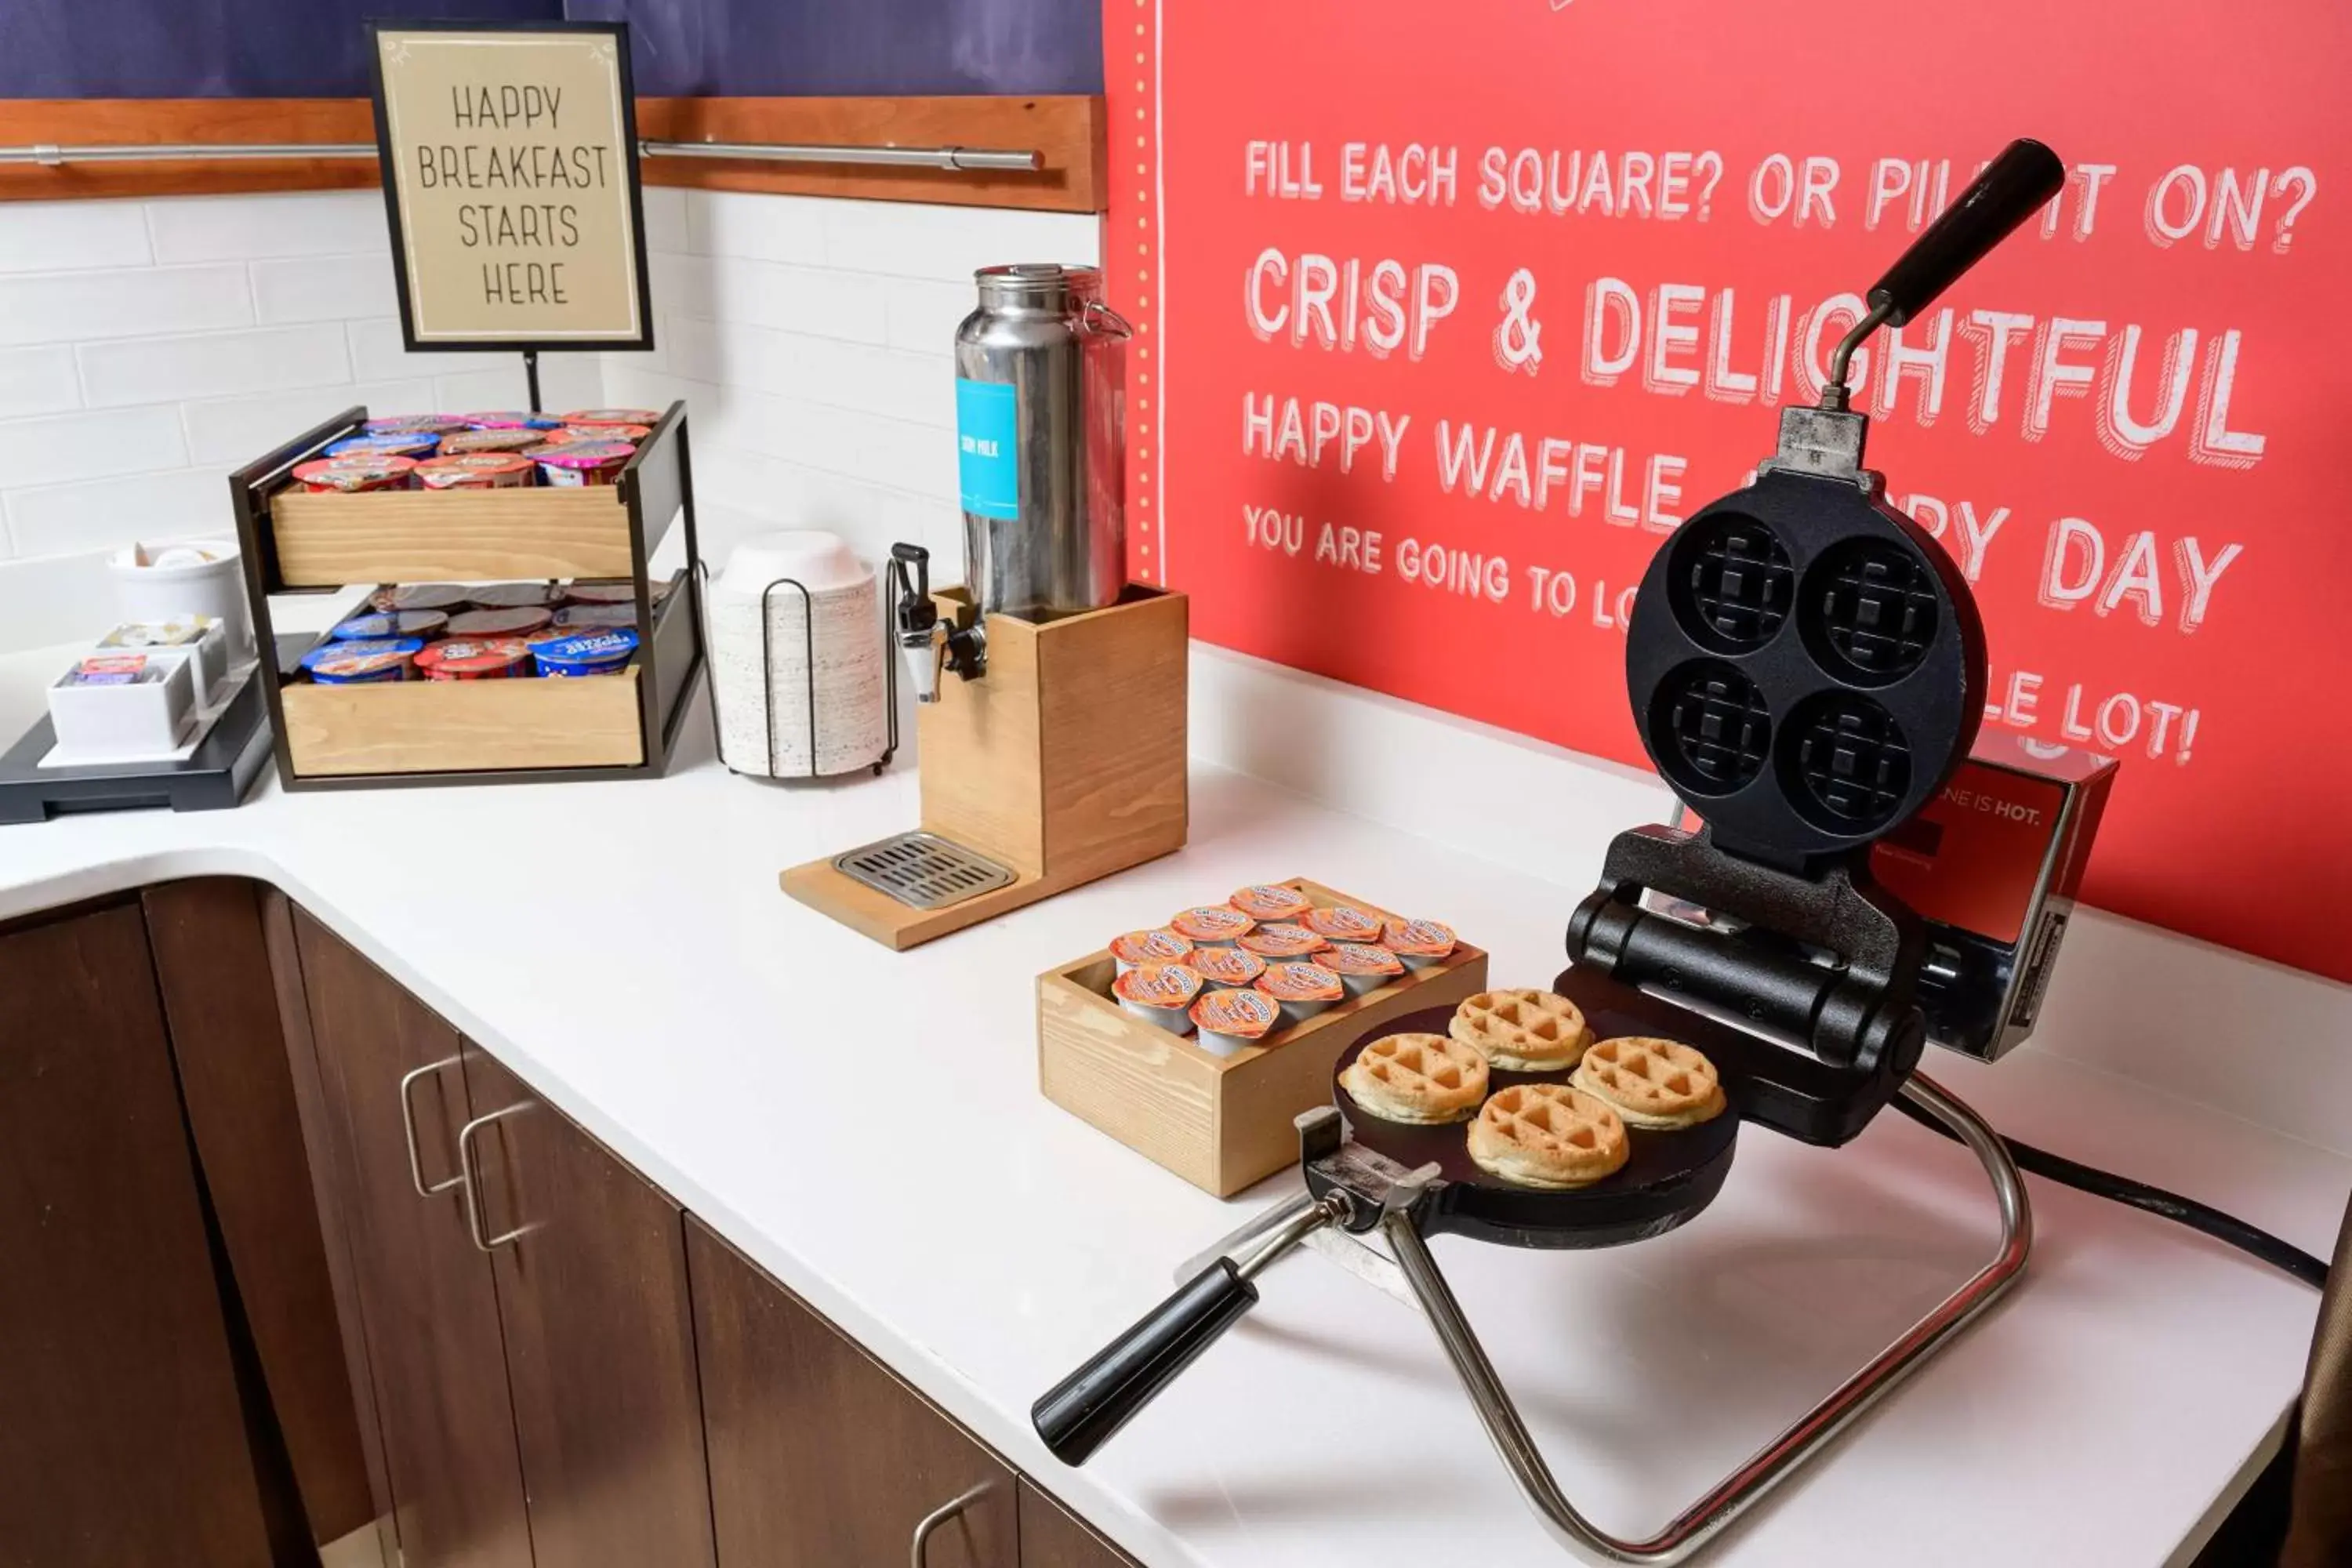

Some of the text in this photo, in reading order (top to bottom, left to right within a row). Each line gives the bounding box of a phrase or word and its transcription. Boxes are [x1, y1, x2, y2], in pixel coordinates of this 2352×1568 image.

[452, 85, 561, 129] HAPPY
[417, 145, 608, 189] BREAKFAST
[1245, 140, 1323, 200] FILL
[1340, 142, 1457, 205] EACH
[1478, 146, 1723, 223] SQUARE?
[1748, 153, 1840, 228] OR
[2143, 164, 2317, 252] ON?
[459, 205, 579, 247] STARTS
[482, 262, 569, 305] HERE
[1244, 247, 2267, 469] CRISP & DELIGHTFUL
[1243, 390, 1411, 481] HAPPY
[1435, 419, 1688, 535] WAFFLE
[2038, 517, 2243, 634] DAY
[1242, 503, 1303, 557] YOU
[1316, 522, 1383, 575] ARE
[1396, 537, 1509, 602] GOING
[1528, 565, 1577, 618] TO
[2060, 683, 2201, 768] LOT!
[1974, 796, 1992, 813] IS
[1994, 802, 2041, 827] HOT.
